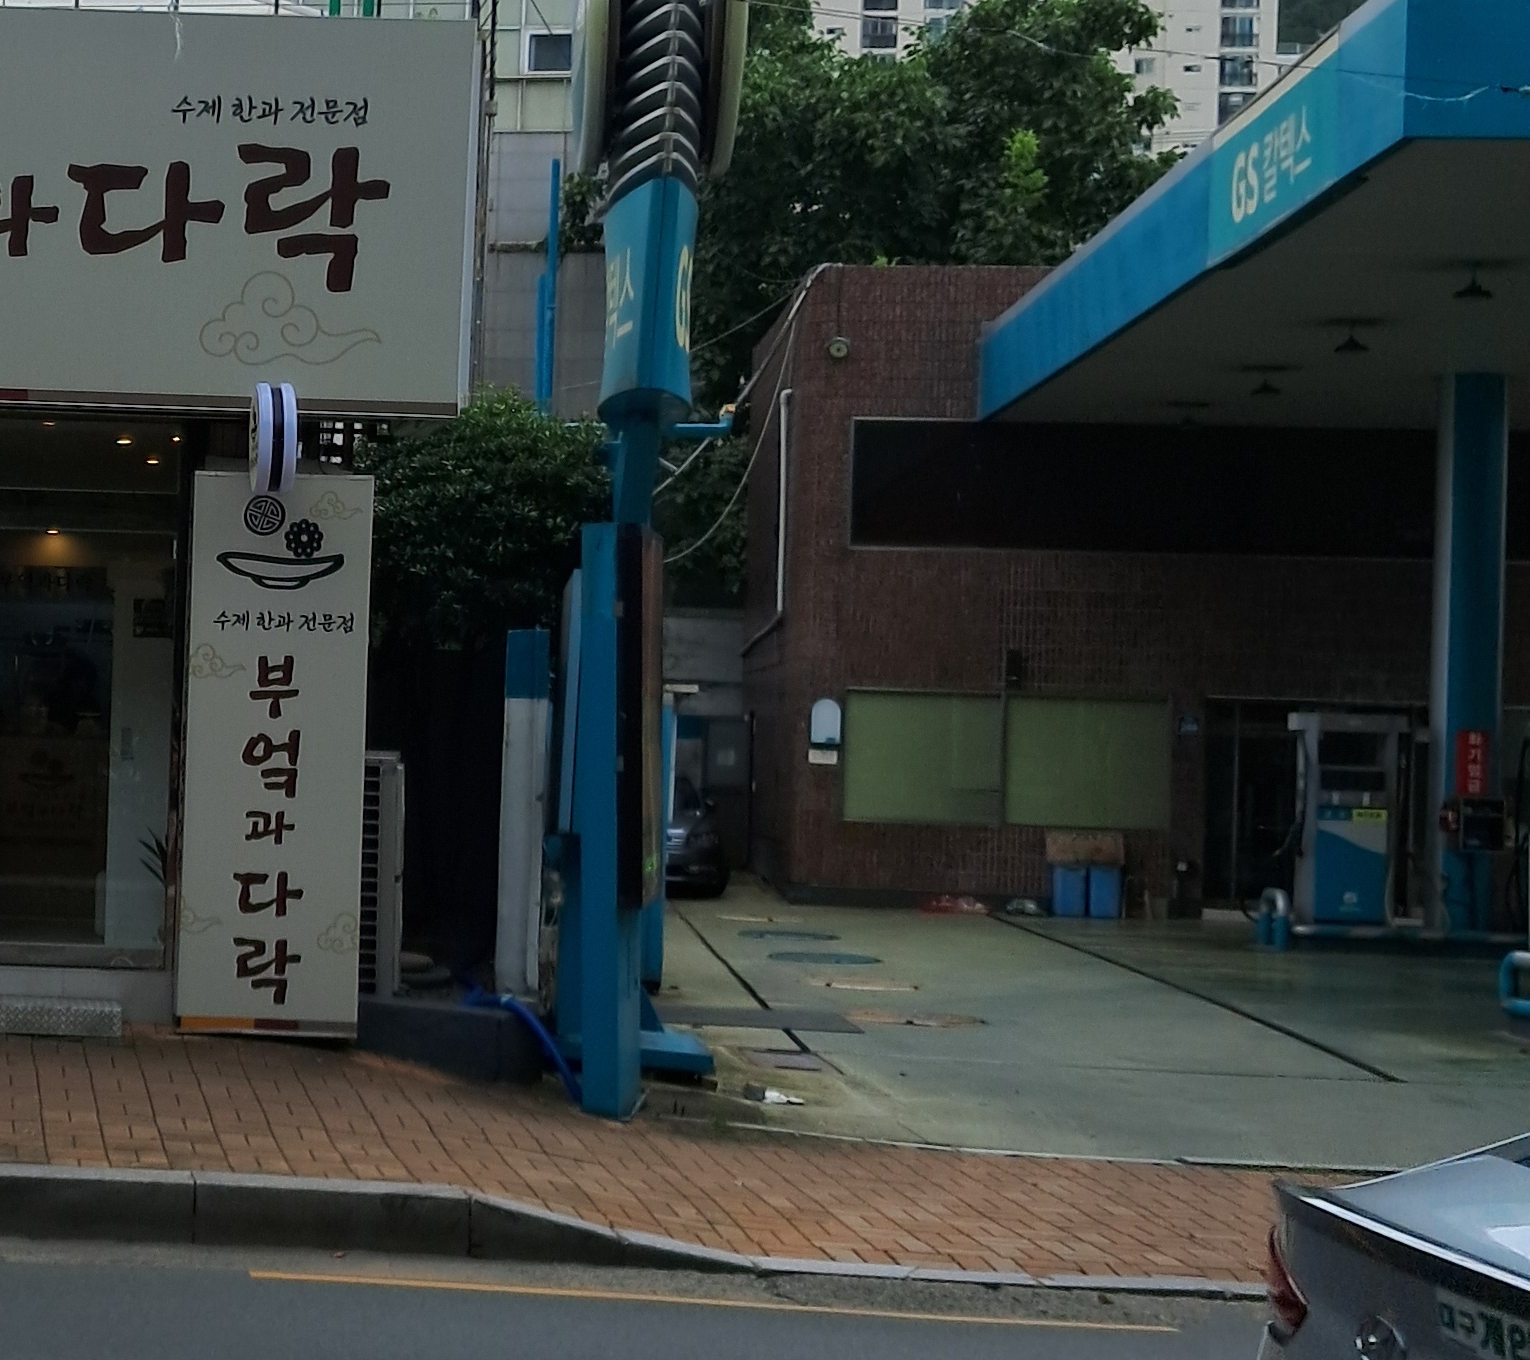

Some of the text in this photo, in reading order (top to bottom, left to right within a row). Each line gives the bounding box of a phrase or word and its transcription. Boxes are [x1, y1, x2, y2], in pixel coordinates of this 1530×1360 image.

[171, 95, 369, 128] 수제 한과 전문점
[213, 610, 356, 634] 수제 한과 전문점
[233, 655, 304, 1005] 부엌과다락
